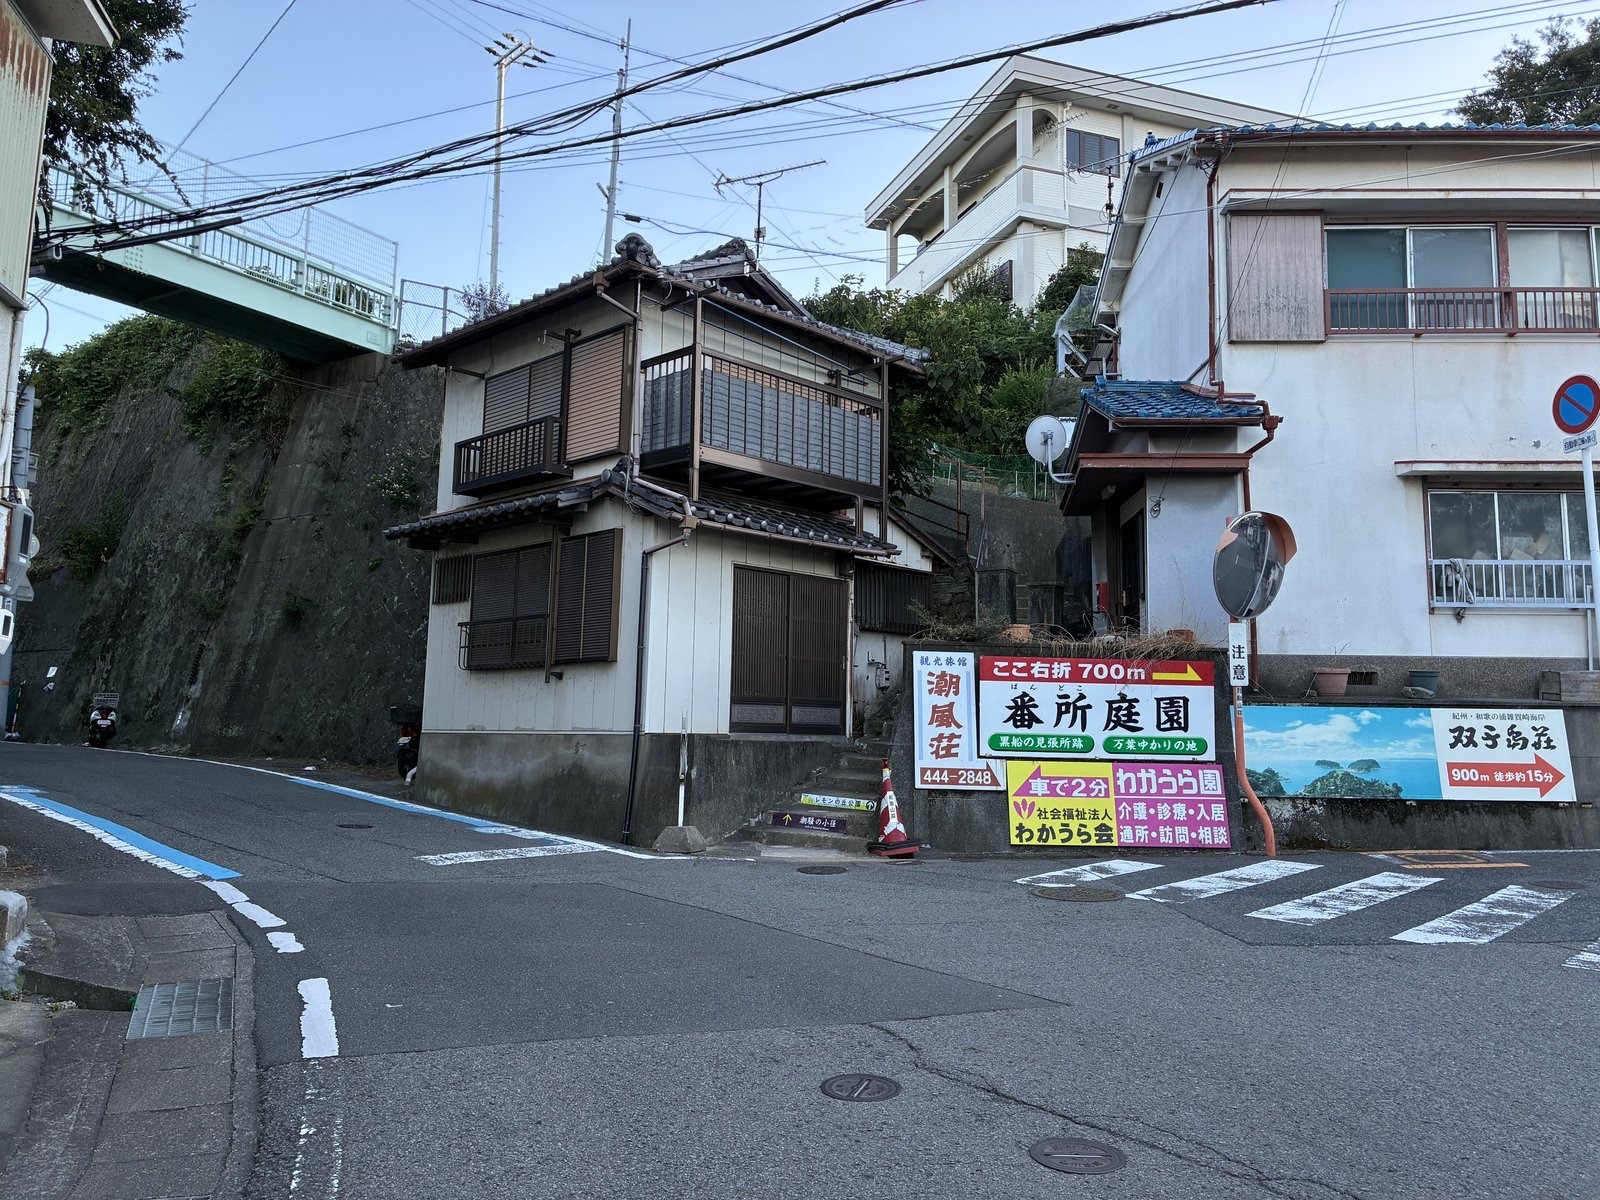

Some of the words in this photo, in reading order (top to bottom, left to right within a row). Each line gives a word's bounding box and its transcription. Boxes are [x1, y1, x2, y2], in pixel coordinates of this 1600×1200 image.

[920, 656, 967, 667] 観光旅館
[993, 661, 1072, 679] ここ右折
[1078, 663, 1146, 680] 700m
[1232, 644, 1246, 680] 注意
[926, 670, 964, 760] 潮風荘
[1003, 691, 1190, 733] 番所庭園
[999, 736, 1084, 750] 黒船の見張所跡
[1113, 739, 1198, 751] 万葉ゆかりの地
[923, 769, 991, 784] 444-2848
[1116, 769, 1222, 795] わかうら園
[1493, 769, 1554, 783] 徒歩約15分
[1029, 778, 1108, 797] 車で2分
[1037, 808, 1113, 821] 社会福祉法人
[1118, 801, 1225, 821] 介護・診療・入居
[1015, 822, 1114, 844] わかうら会
[1119, 825, 1229, 845] 通所・訪問・相談
